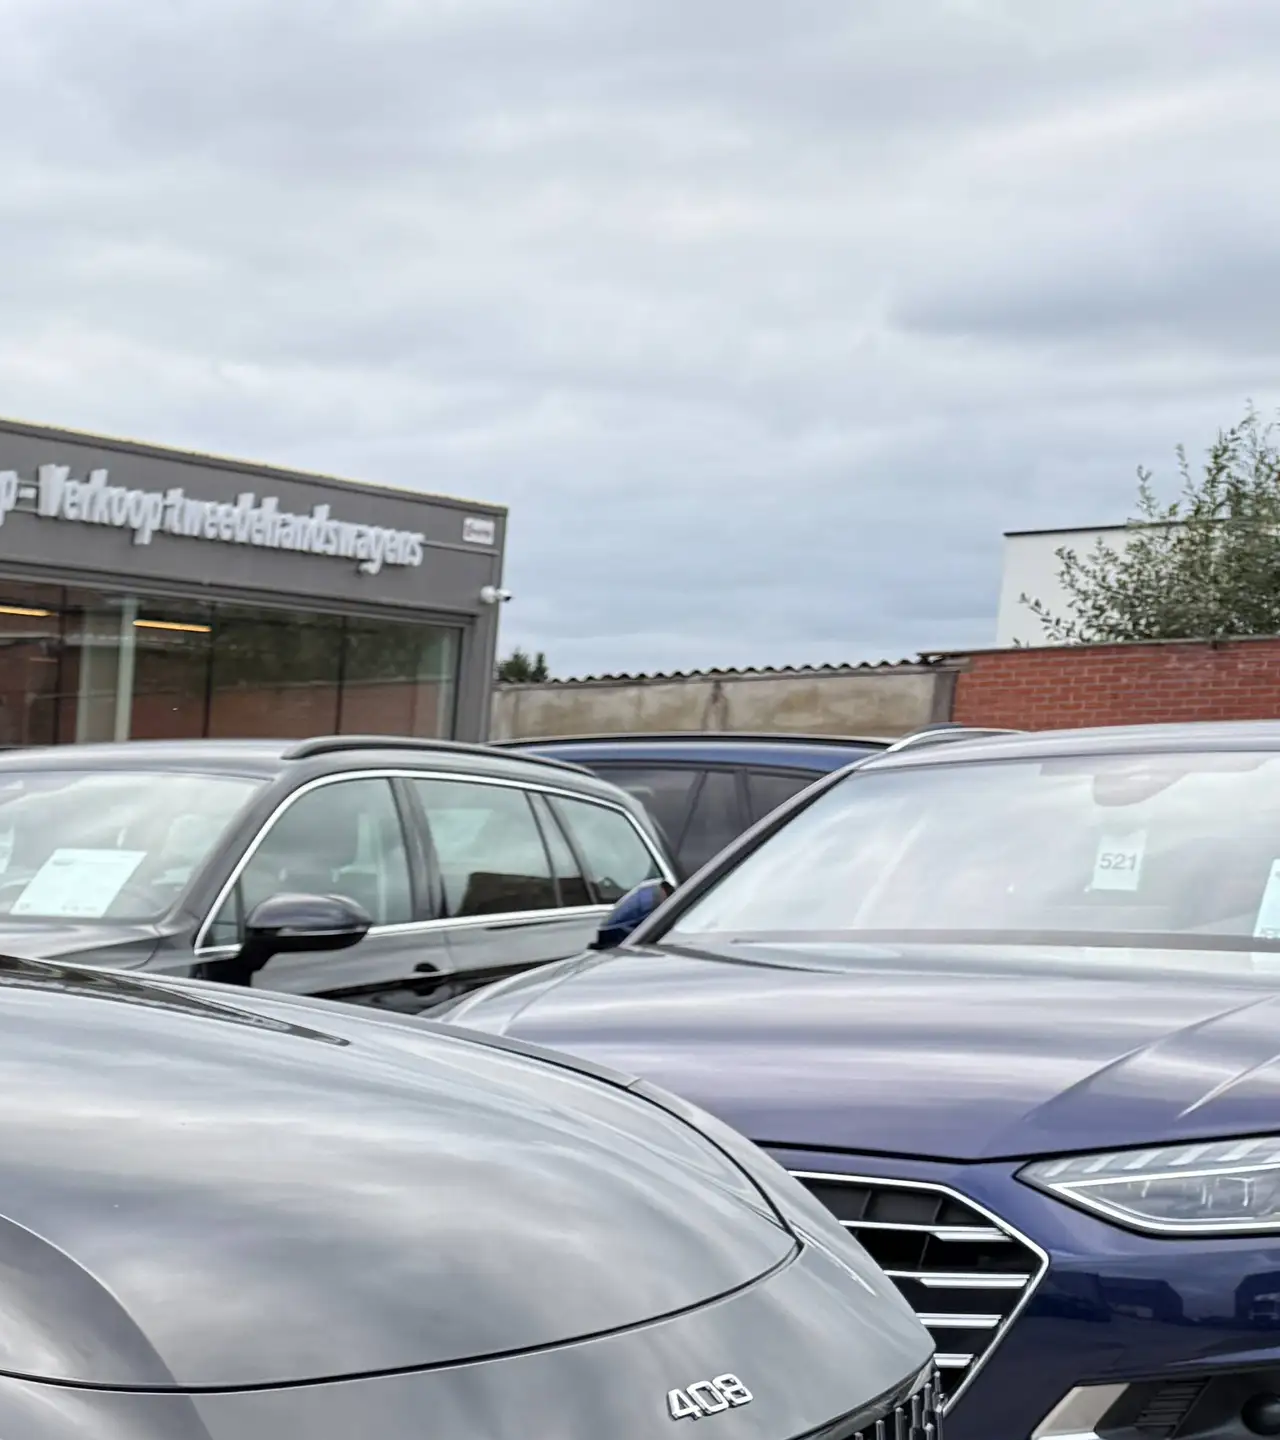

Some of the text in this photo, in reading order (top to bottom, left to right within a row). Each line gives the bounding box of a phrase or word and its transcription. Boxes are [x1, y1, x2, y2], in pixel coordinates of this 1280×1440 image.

[38, 463, 163, 545] Verkoop
[1098, 853, 1138, 871] 521
[666, 1373, 754, 1421] 408
